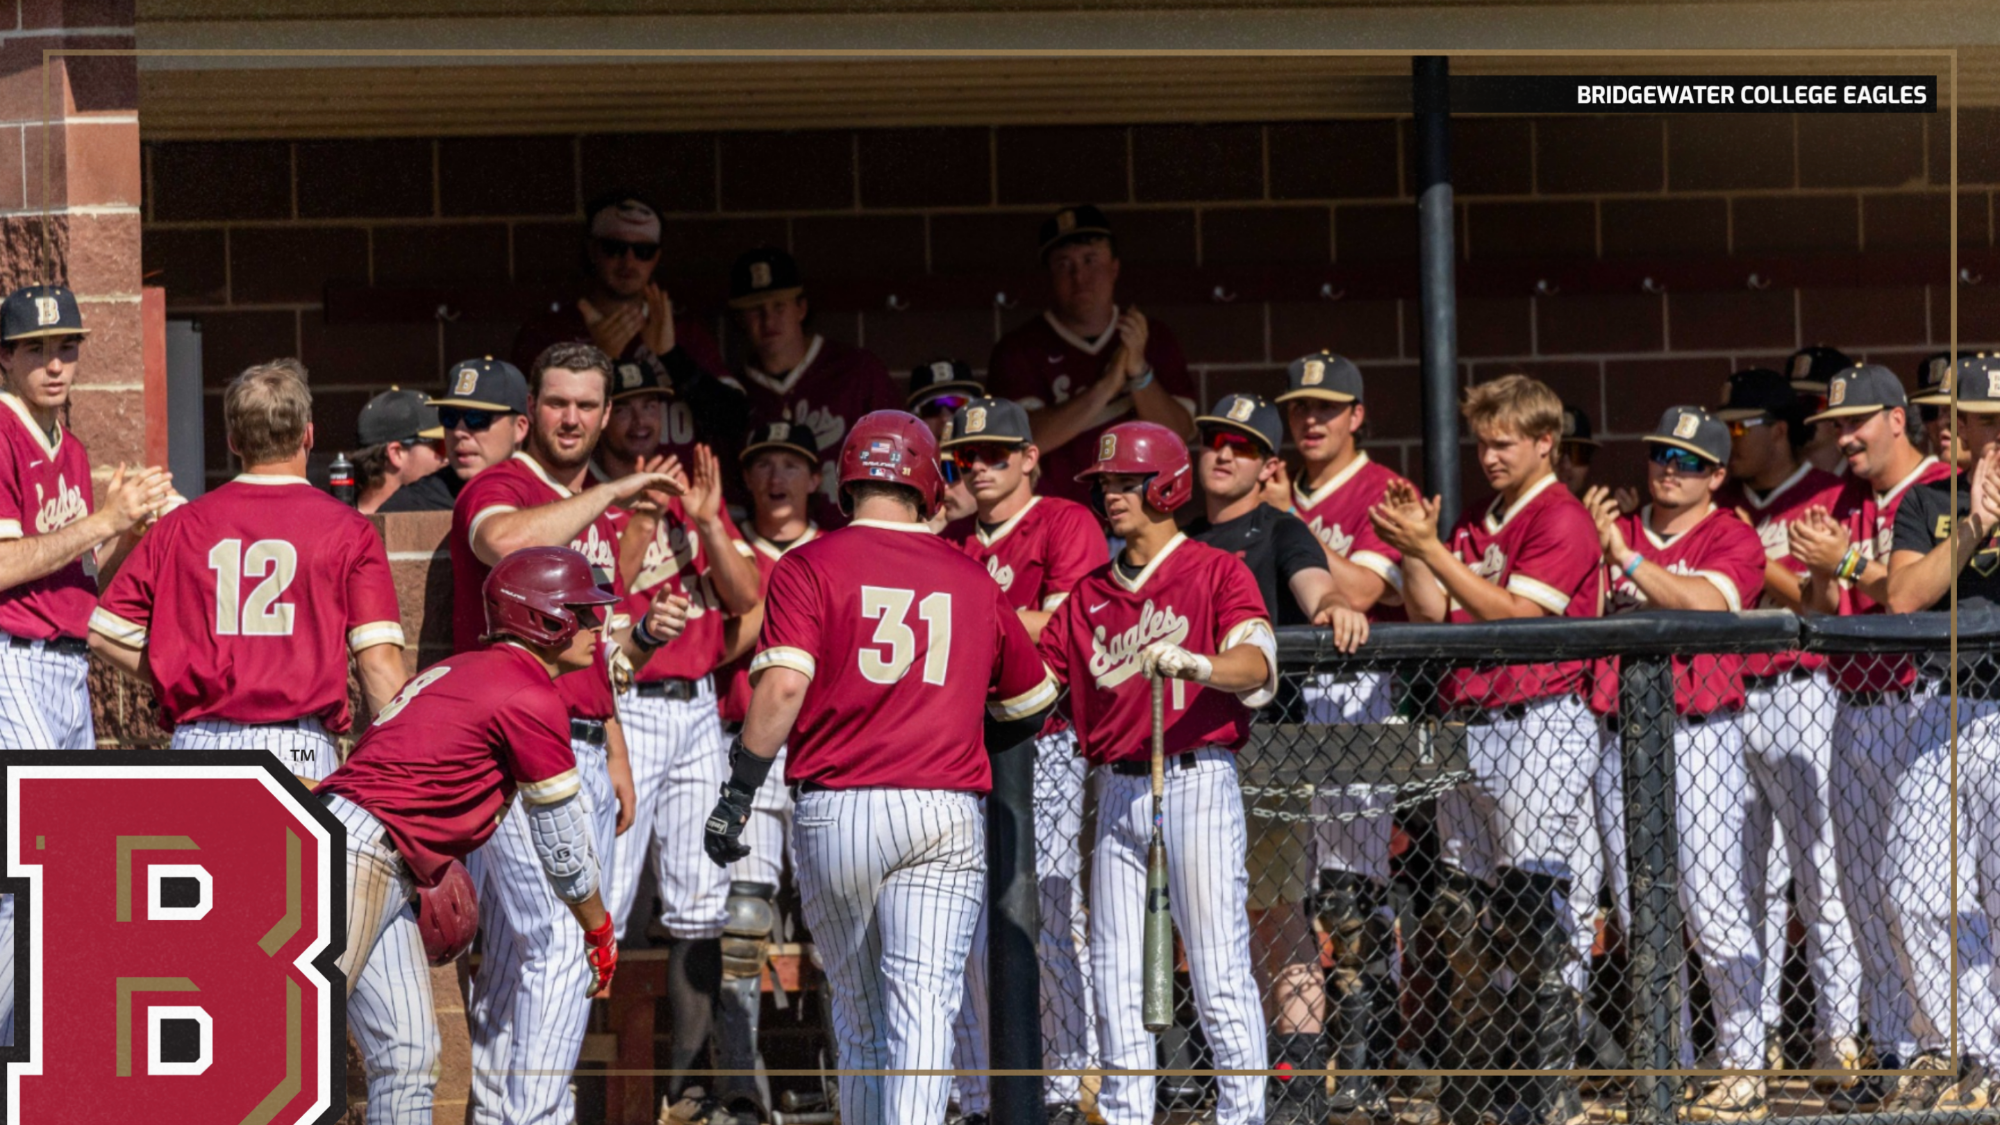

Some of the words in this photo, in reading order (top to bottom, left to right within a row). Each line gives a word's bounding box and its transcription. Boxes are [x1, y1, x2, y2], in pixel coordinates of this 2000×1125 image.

[35, 297, 61, 326] B
[454, 368, 479, 396] B
[1301, 360, 1326, 386] B
[1829, 378, 1847, 406] B
[965, 406, 987, 434] B
[1226, 397, 1256, 422] B
[1672, 412, 1700, 439] B
[1098, 433, 1117, 461] B
[208, 538, 298, 636] 12
[858, 585, 952, 687] 31
[1089, 598, 1189, 690] Eagles
